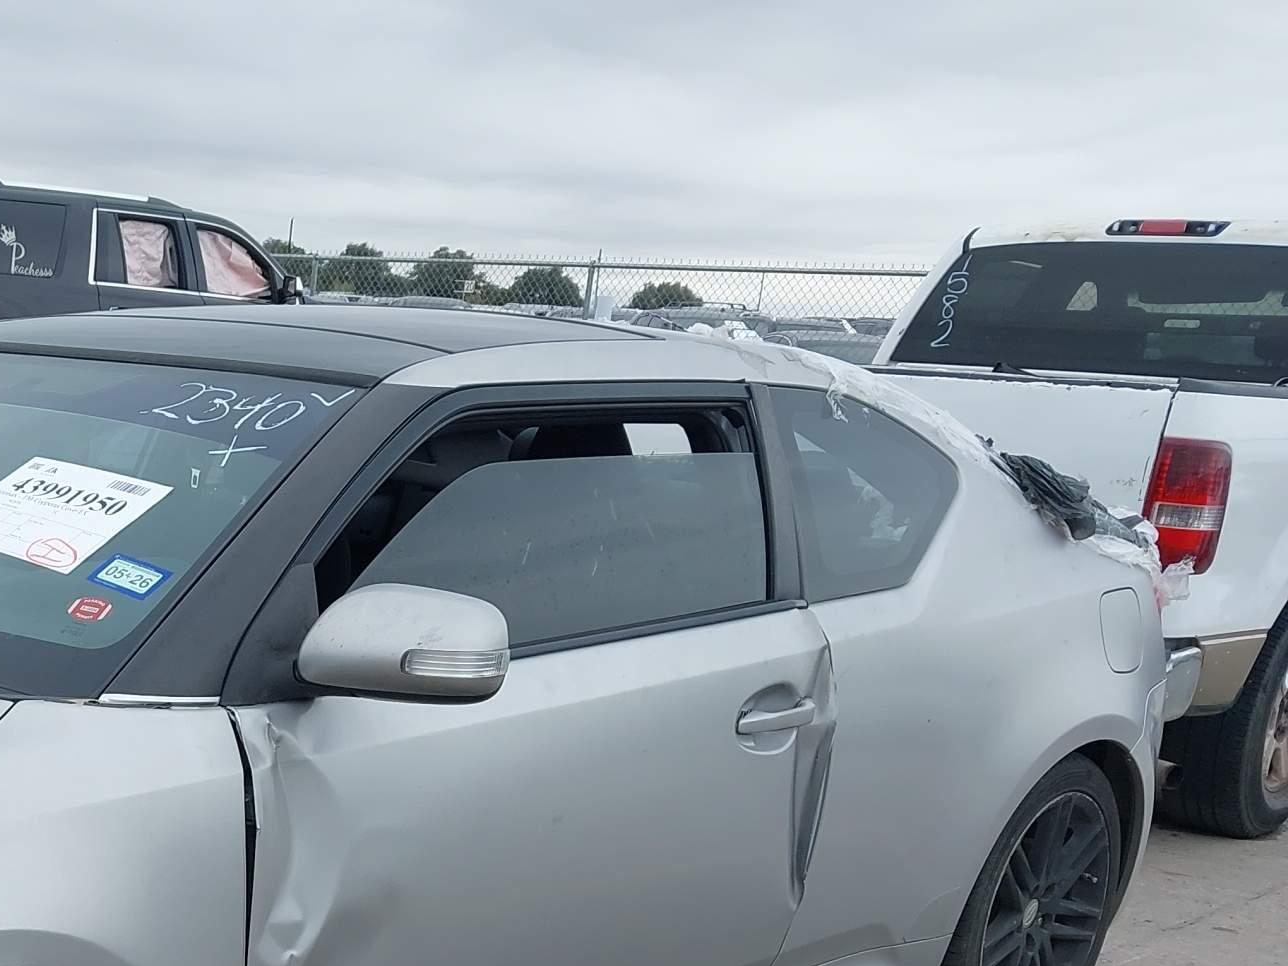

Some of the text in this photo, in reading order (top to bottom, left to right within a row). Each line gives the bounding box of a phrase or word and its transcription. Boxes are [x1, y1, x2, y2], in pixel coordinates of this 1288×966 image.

[10, 241, 54, 277] Peachesss
[930, 254, 973, 348] 1582
[150, 382, 306, 431] 2340
[11, 477, 128, 516] 43991950
